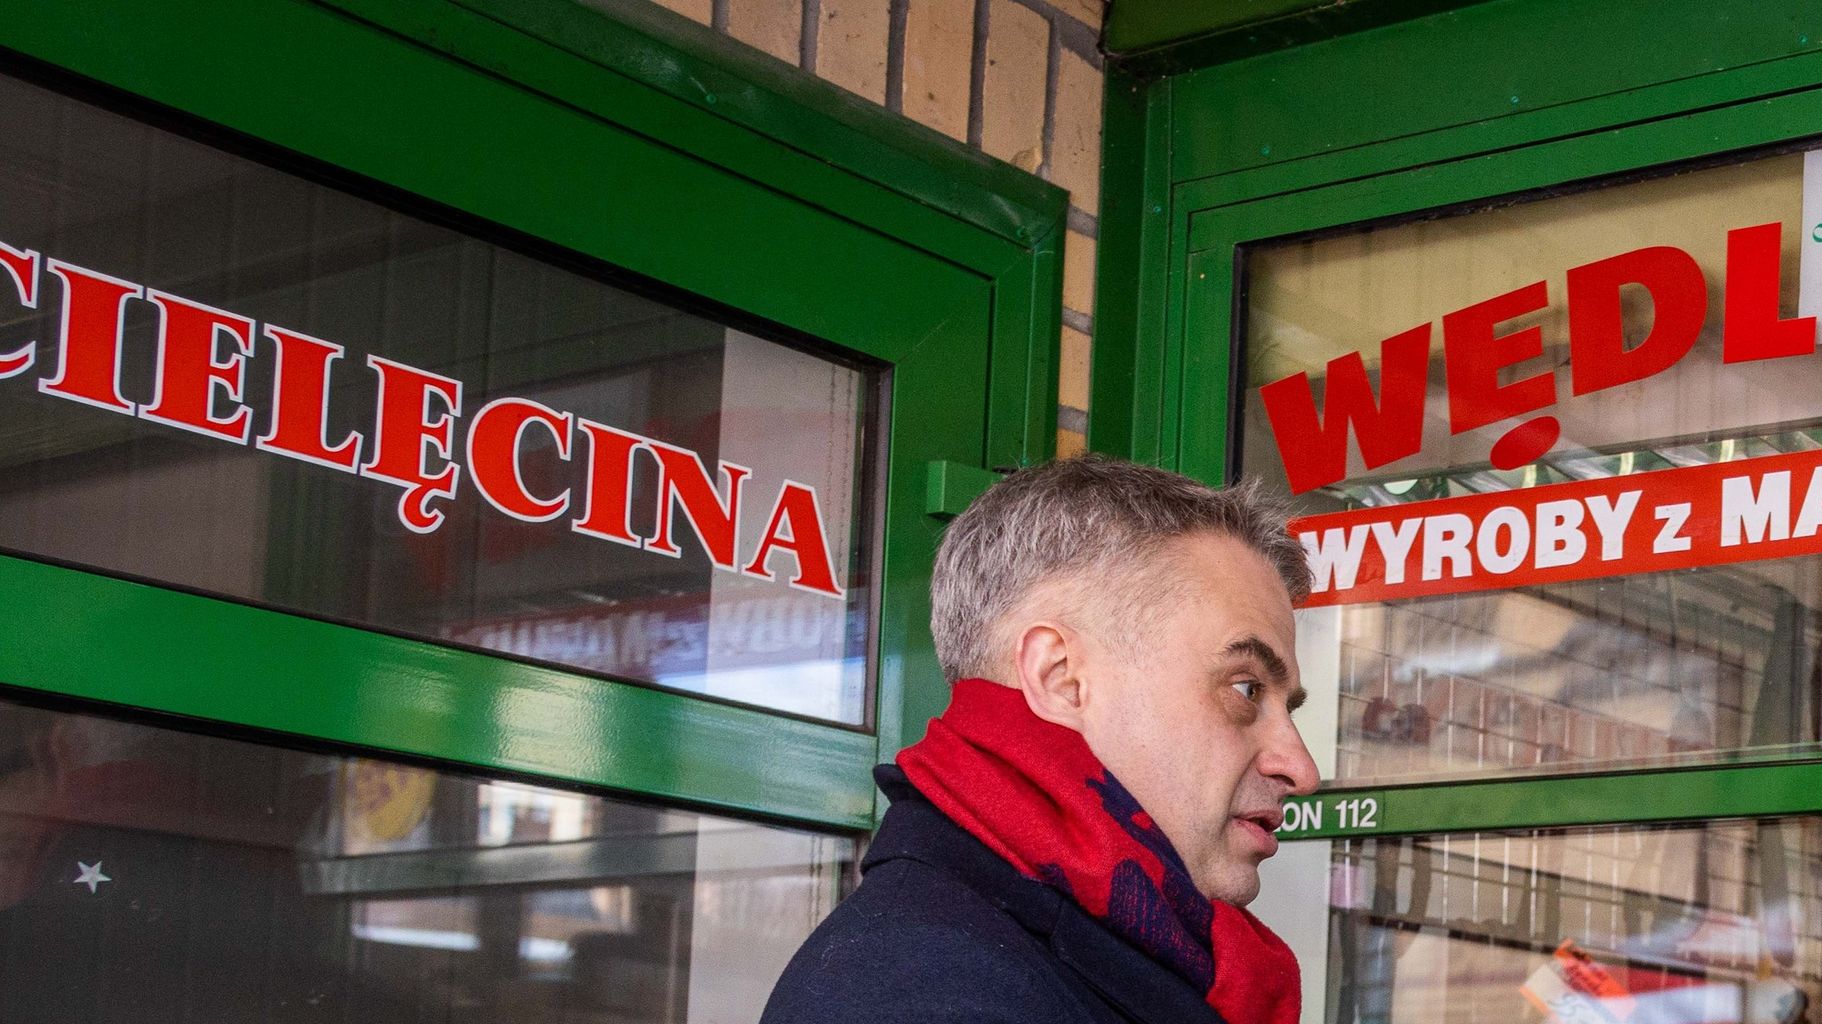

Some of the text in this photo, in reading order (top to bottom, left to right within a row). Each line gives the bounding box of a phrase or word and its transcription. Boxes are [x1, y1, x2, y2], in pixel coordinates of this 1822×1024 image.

[1298, 489, 1643, 594] WYROBY
[1653, 502, 1692, 554] z
[1276, 798, 1377, 833] ON 112
